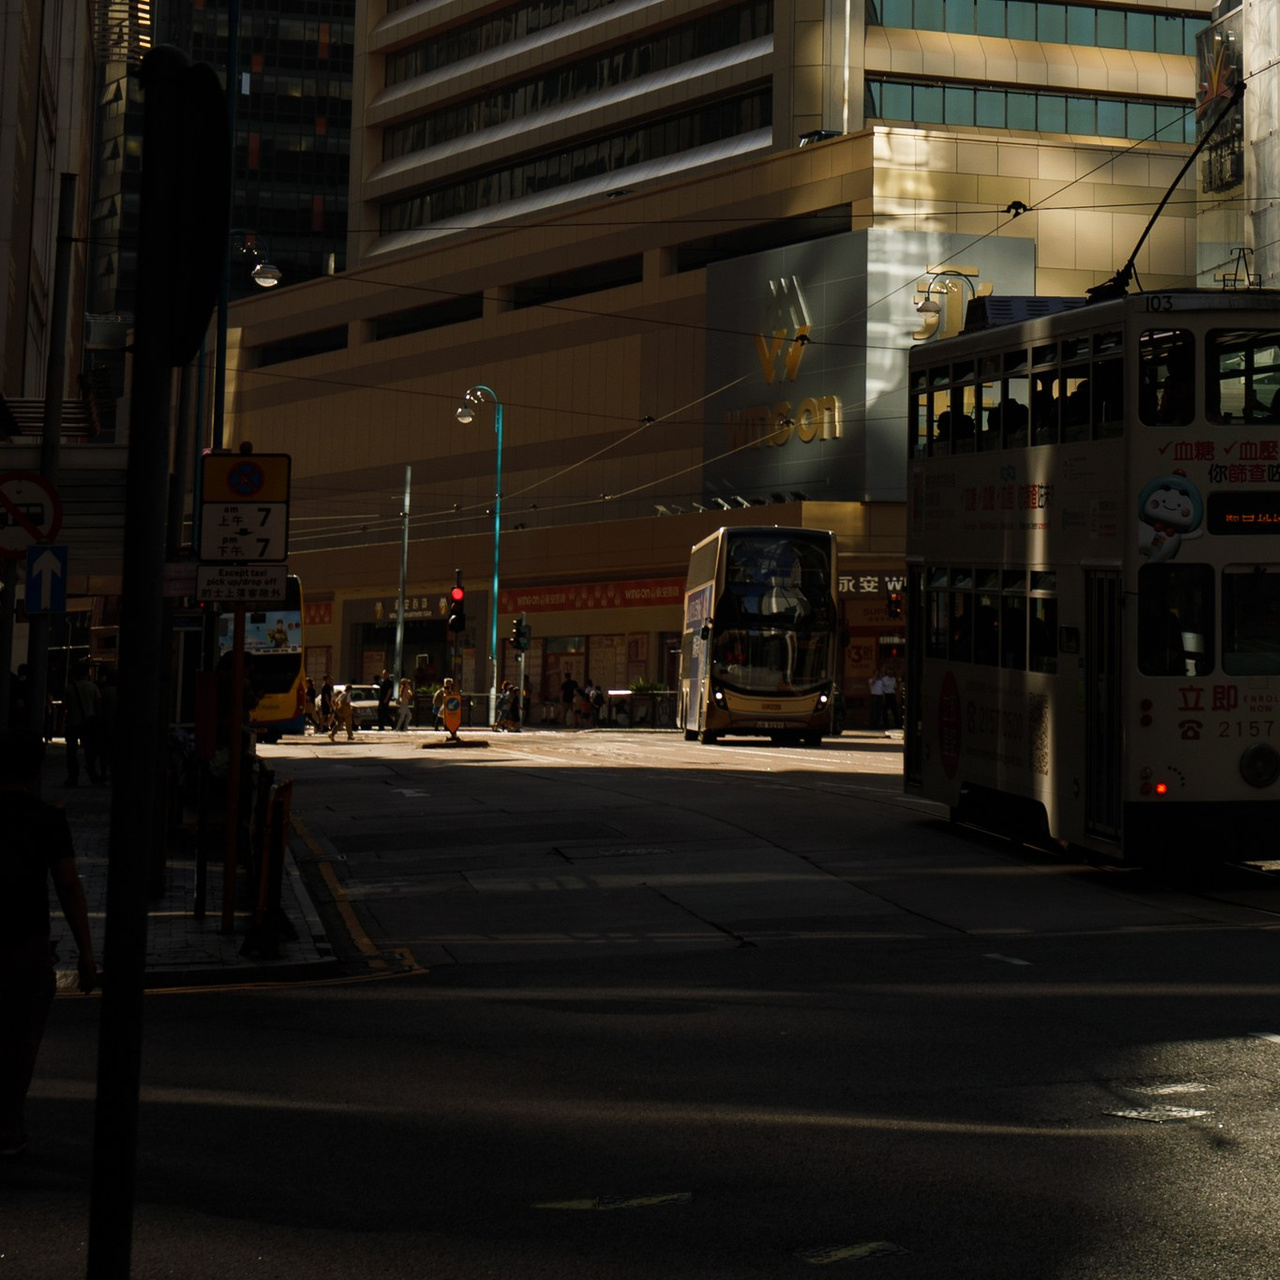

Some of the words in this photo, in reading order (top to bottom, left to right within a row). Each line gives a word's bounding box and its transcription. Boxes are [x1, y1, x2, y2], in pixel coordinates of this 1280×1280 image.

[1146, 296, 1173, 312] 103
[1173, 441, 1215, 461] 血糖
[1238, 440, 1279, 461] 血壓
[218, 516, 243, 527] 上午
[258, 508, 271, 527] 7
[217, 546, 242, 557] 下午
[222, 537, 238, 545] pm
[256, 539, 270, 557] 7
[219, 569, 249, 578] Except
[251, 569, 267, 577] taxi
[207, 578, 224, 586] pick
[228, 578, 262, 587] up/drop
[264, 578, 277, 586] off
[838, 576, 879, 593] 永安
[1178, 685, 1237, 711] 立即
[1243, 695, 1279, 704] ENROL
[1250, 705, 1273, 713] NOW
[1219, 721, 1275, 738] 2157
